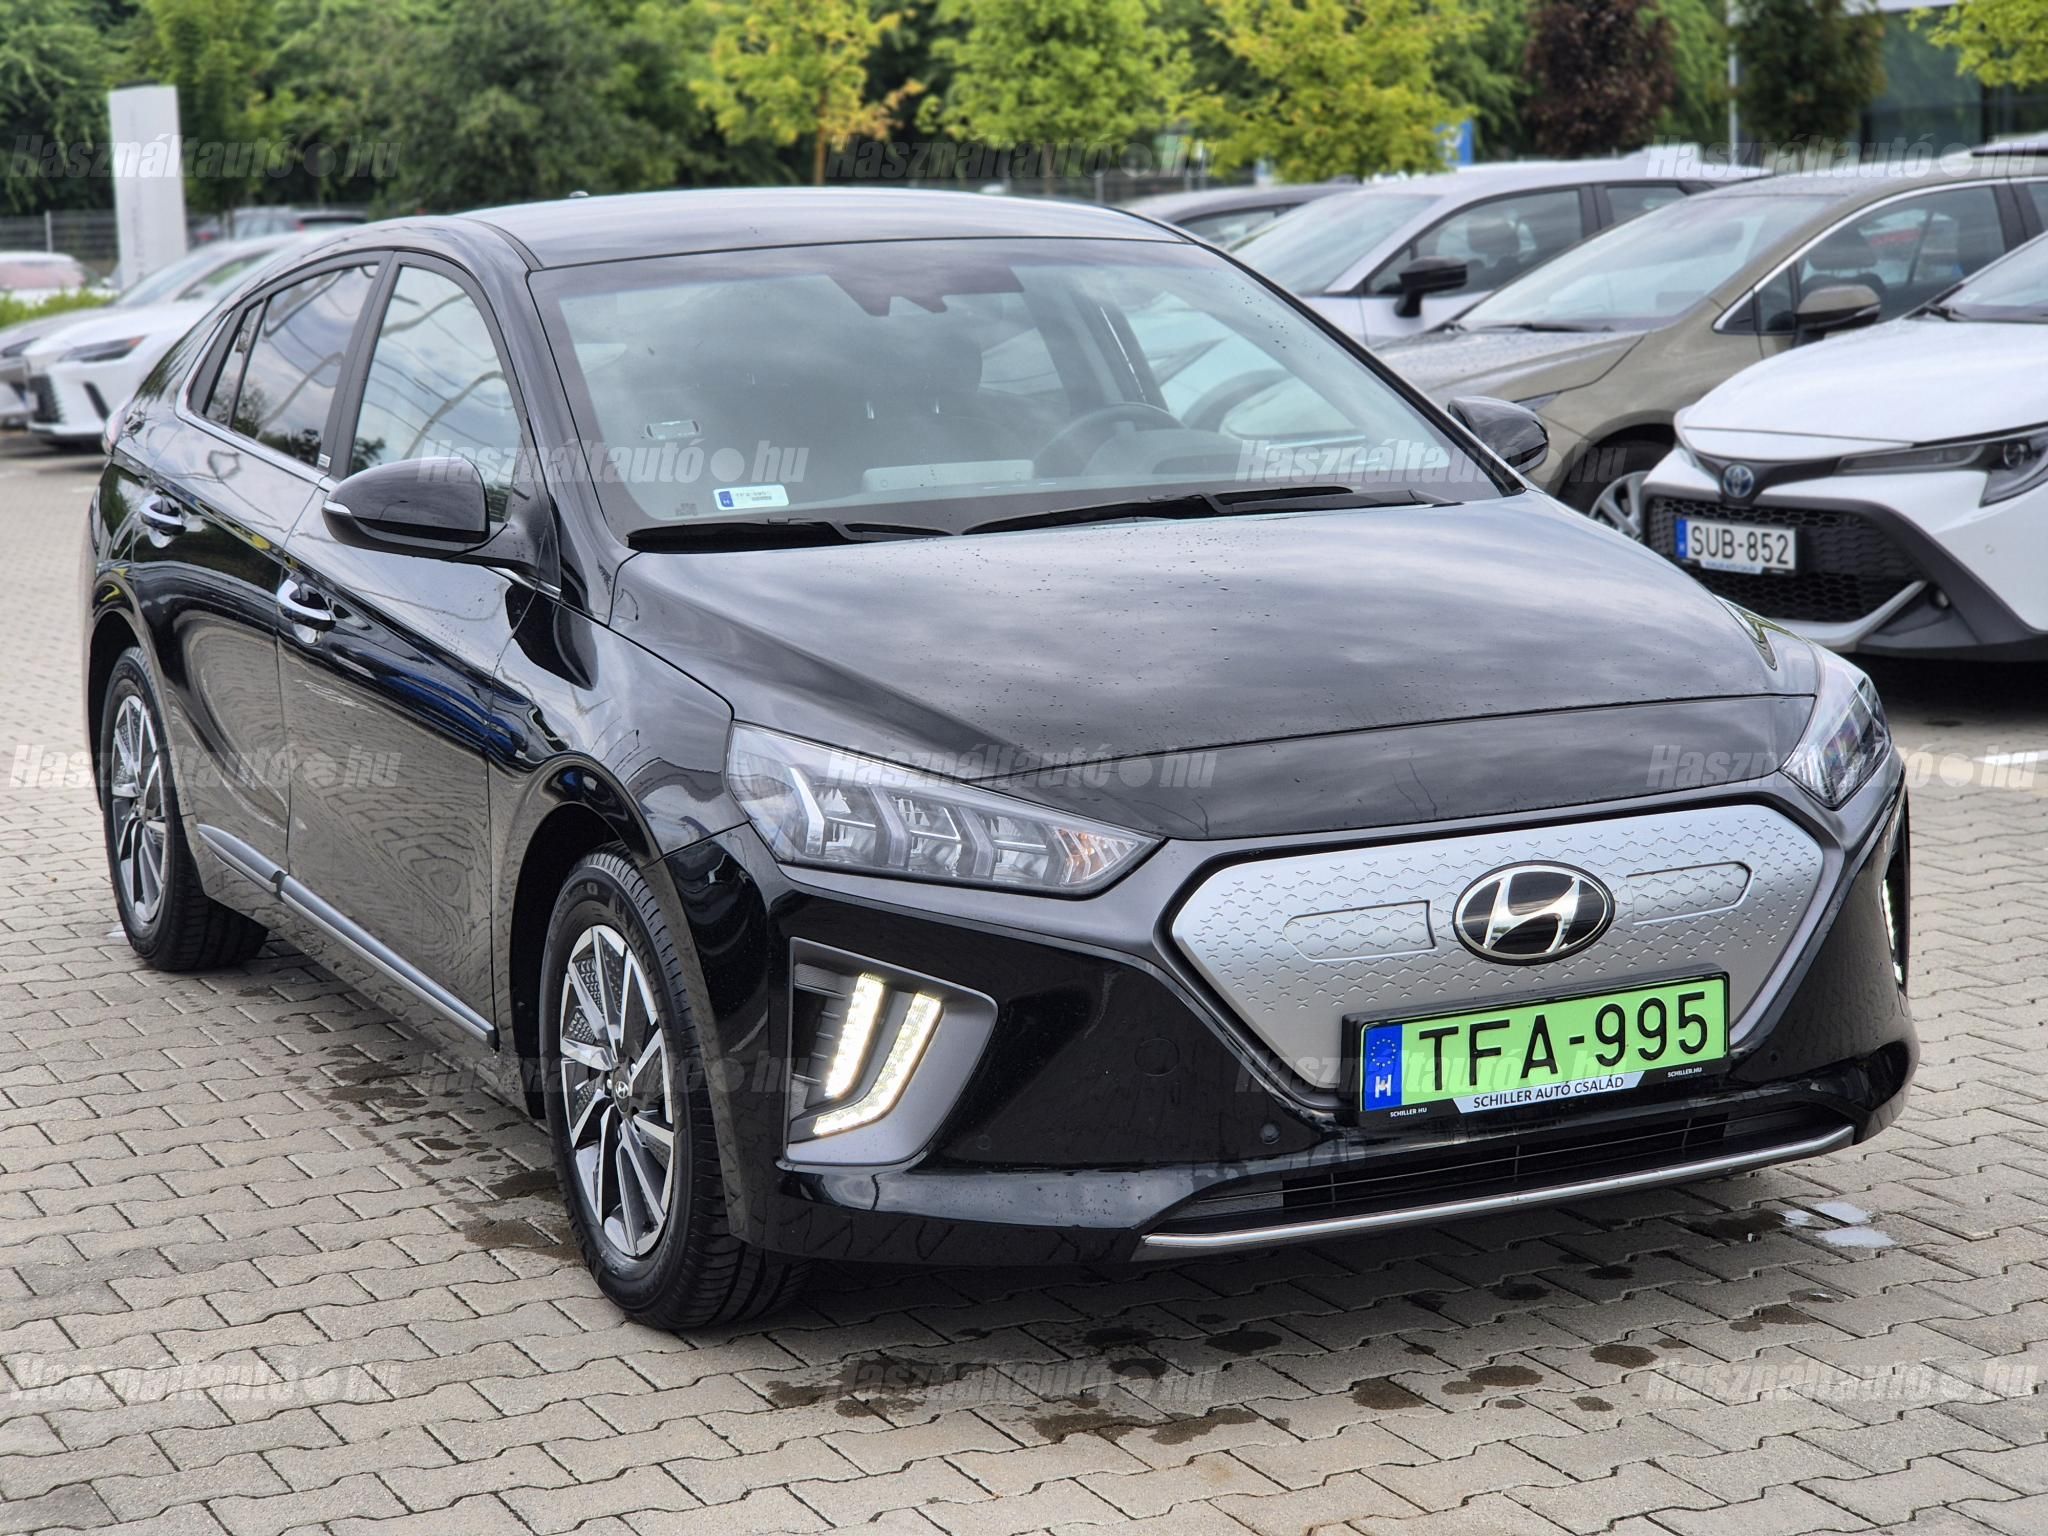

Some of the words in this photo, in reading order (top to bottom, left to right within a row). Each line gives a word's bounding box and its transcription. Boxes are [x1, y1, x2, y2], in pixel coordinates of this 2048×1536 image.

[1691, 526, 1789, 565] SUB-852
[1419, 991, 1708, 1091] TFA-995
[1374, 1074, 1392, 1099] H
[1473, 1090, 1532, 1109] SCHILLER
[1535, 1080, 1571, 1100] AUTÓ
[1574, 1074, 1624, 1094] CSALÁD
